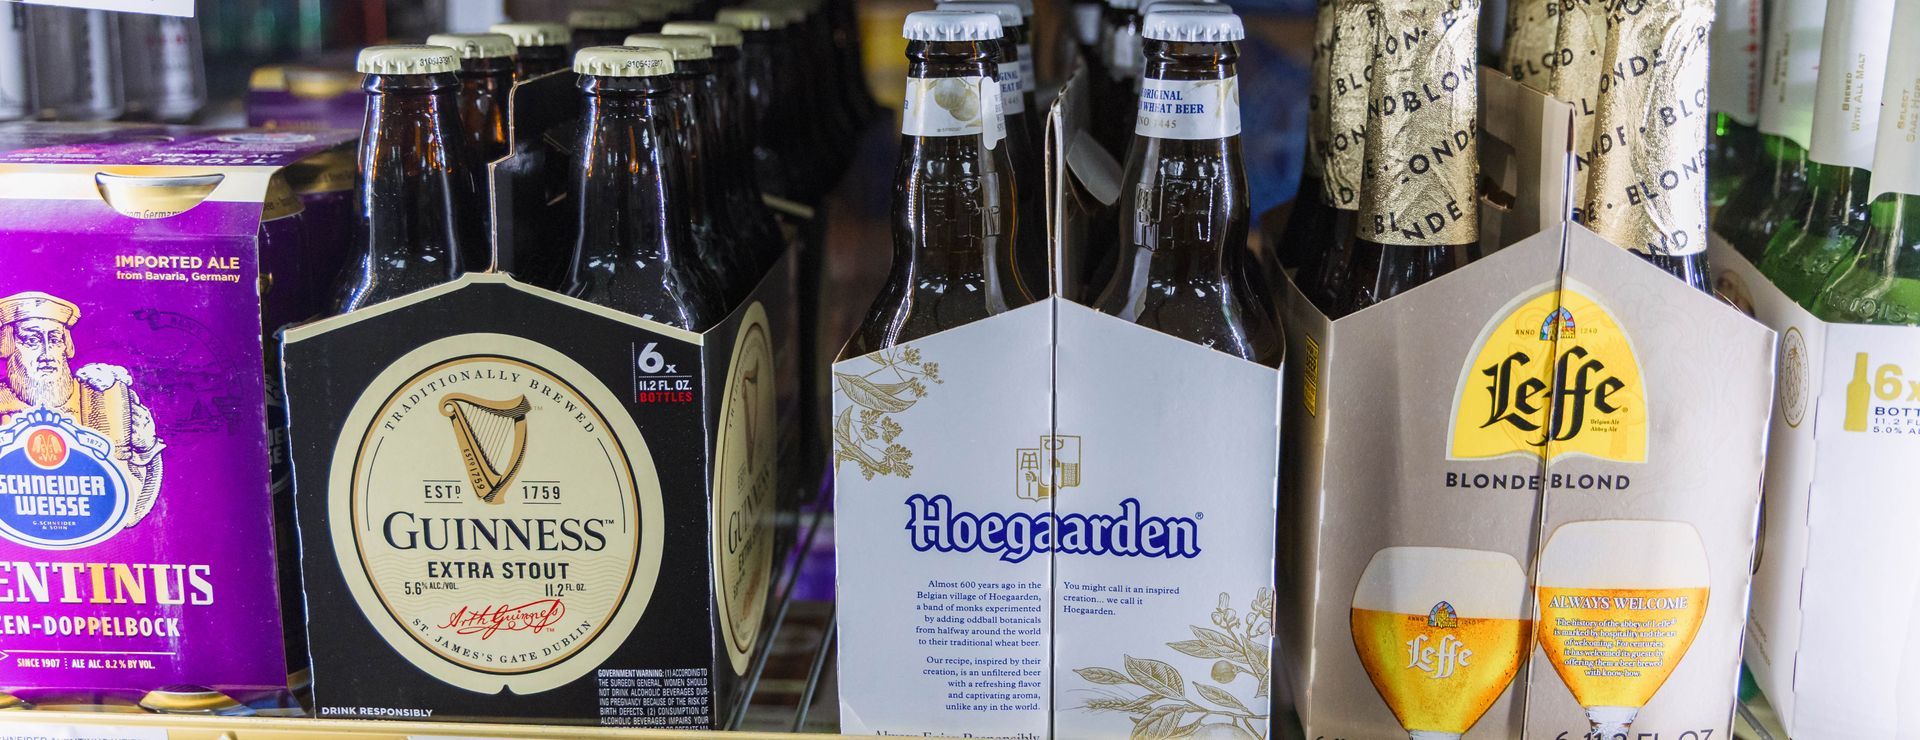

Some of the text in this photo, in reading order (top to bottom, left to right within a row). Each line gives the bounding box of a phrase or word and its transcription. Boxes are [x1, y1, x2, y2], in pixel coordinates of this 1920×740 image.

[1842, 72, 1852, 111] BREWED
[1175, 104, 1204, 114] BEER
[115, 255, 240, 270] IMPORTED ALE
[116, 270, 240, 283] from Bavaria, Germany
[640, 380, 692, 391] 11.2 FL. OZ.
[384, 369, 596, 434] TRADITIONALLY BREWED
[640, 392, 693, 403] BOTTLES
[1446, 472, 1631, 491] BLONDE BLOND
[522, 486, 560, 499] 1759
[15, 496, 90, 516] WEISSE
[428, 561, 570, 579] EXTRA STOUT
[404, 582, 428, 595] 5.6%
[545, 583, 587, 597] 11.2 FL. OZ.
[928, 580, 957, 588] Almost
[978, 582, 999, 590] years
[1064, 582, 1079, 590] You
[1082, 583, 1106, 592] might
[1146, 586, 1180, 595] inspired
[917, 591, 947, 600] Belgian
[950, 592, 976, 601] village
[989, 593, 1041, 601] Hoegaarden,
[1064, 594, 1104, 603] creation...
[1120, 597, 1135, 605] call
[1137, 597, 1142, 605] it
[923, 603, 943, 611] band
[985, 605, 1041, 613] experimented
[1550, 596, 1688, 610] ALWAYS WELCOME
[1064, 605, 1116, 615] Hoegaarden.
[925, 615, 934, 623] by
[937, 616, 964, 624] adding
[0, 615, 180, 637] EN-DOPPELBOCK
[916, 626, 935, 634] from
[937, 627, 969, 636] halfway
[413, 618, 592, 664] ST. JAMES'S GATE DUBLIN
[995, 639, 1019, 647] wheat
[926, 656, 943, 664] Our
[945, 657, 972, 666] recipe,
[975, 658, 1007, 666] inspired
[1010, 658, 1019, 666] by
[1407, 634, 1473, 679] Leffe
[17, 658, 39, 668] SINCE
[42, 658, 60, 668] 1907
[72, 659, 85, 668] ALE
[88, 659, 104, 669] ALC.
[119, 660, 126, 669] %
[127, 660, 137, 669] BY
[139, 660, 155, 669] VOL.
[923, 668, 958, 676] creation,
[975, 680, 1016, 689] refreshing
[966, 692, 1010, 700] captivating
[321, 706, 433, 717] DRINK RESPONSIBLY
[946, 703, 971, 711] unlike
